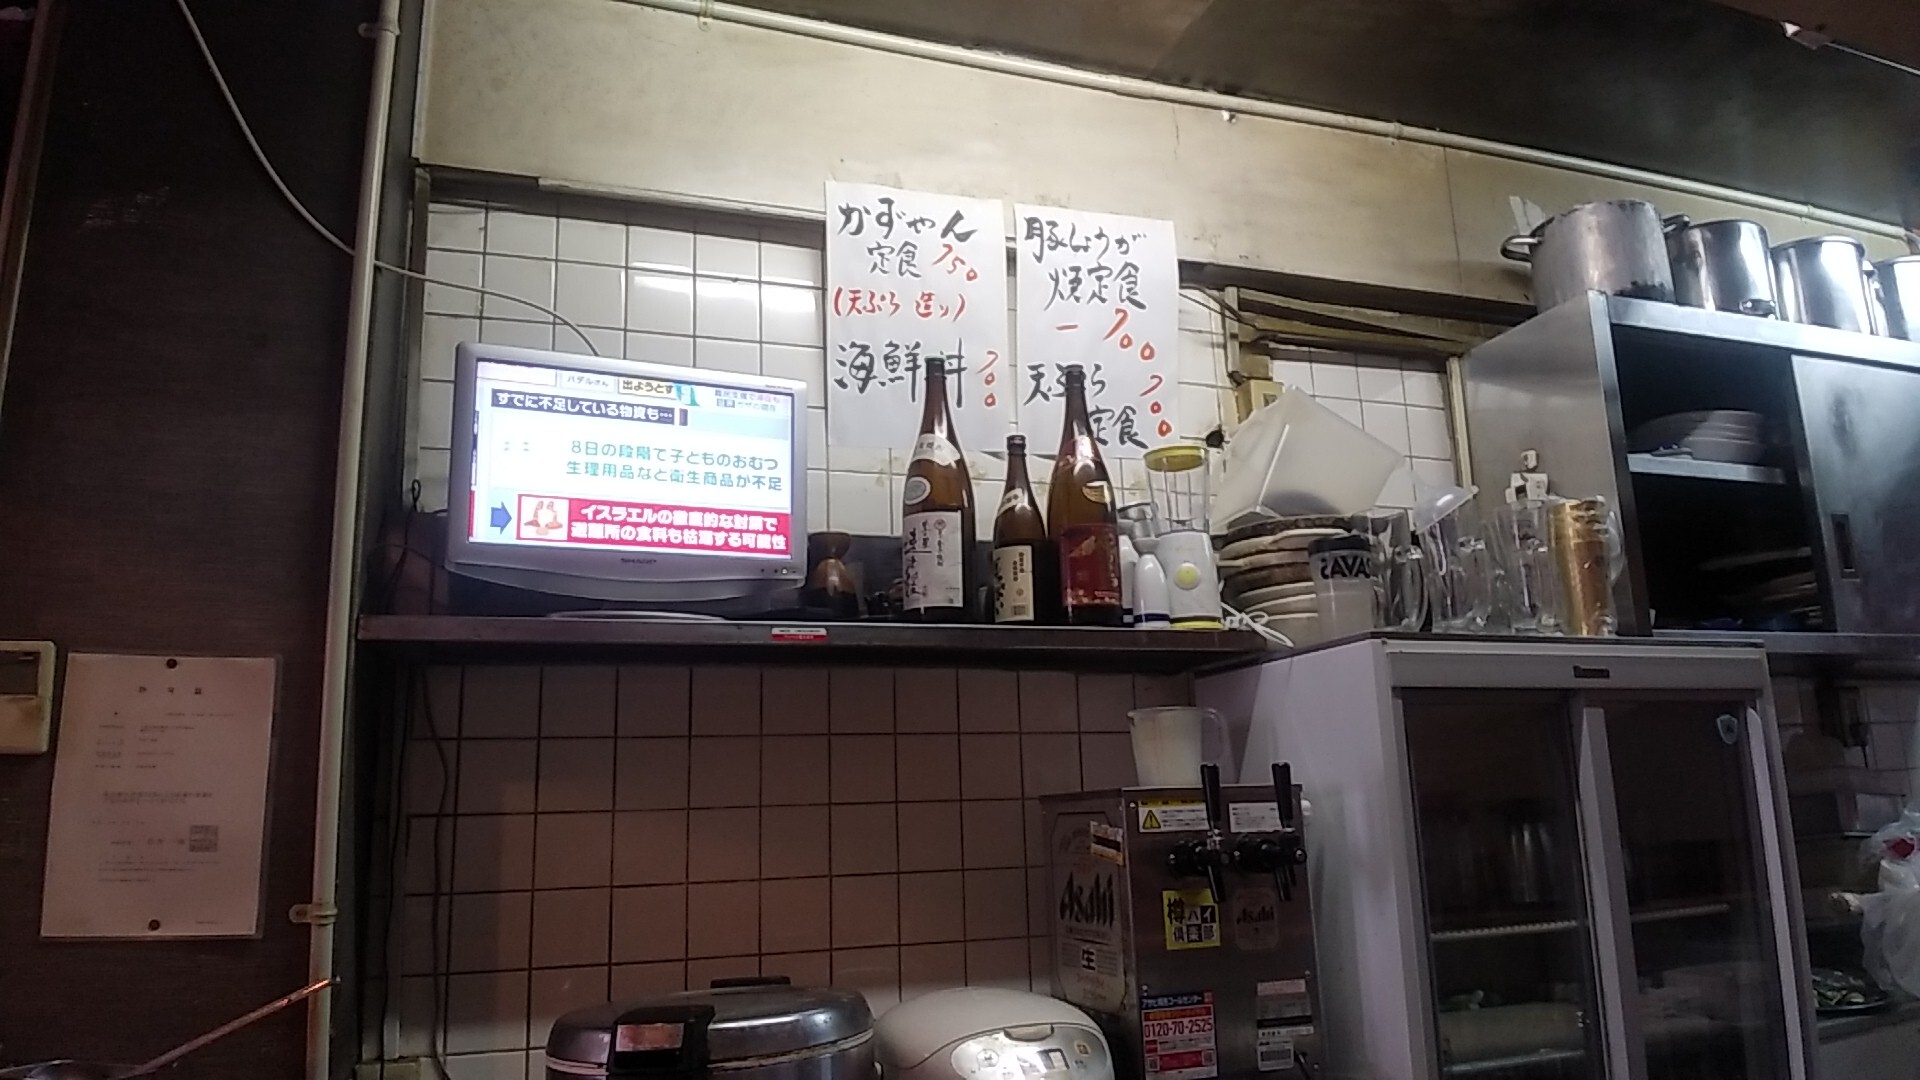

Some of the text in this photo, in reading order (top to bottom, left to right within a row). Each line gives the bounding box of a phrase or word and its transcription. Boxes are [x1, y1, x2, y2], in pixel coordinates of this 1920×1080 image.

[867, 241, 978, 281] 定食 750
[1023, 216, 1147, 264] 豚しょうが
[1043, 261, 1147, 311] 焼定食
[1089, 404, 1149, 449] 定食
[1058, 871, 1115, 929] Asahi
[1144, 1017, 1213, 1038] 0120-70-2525
